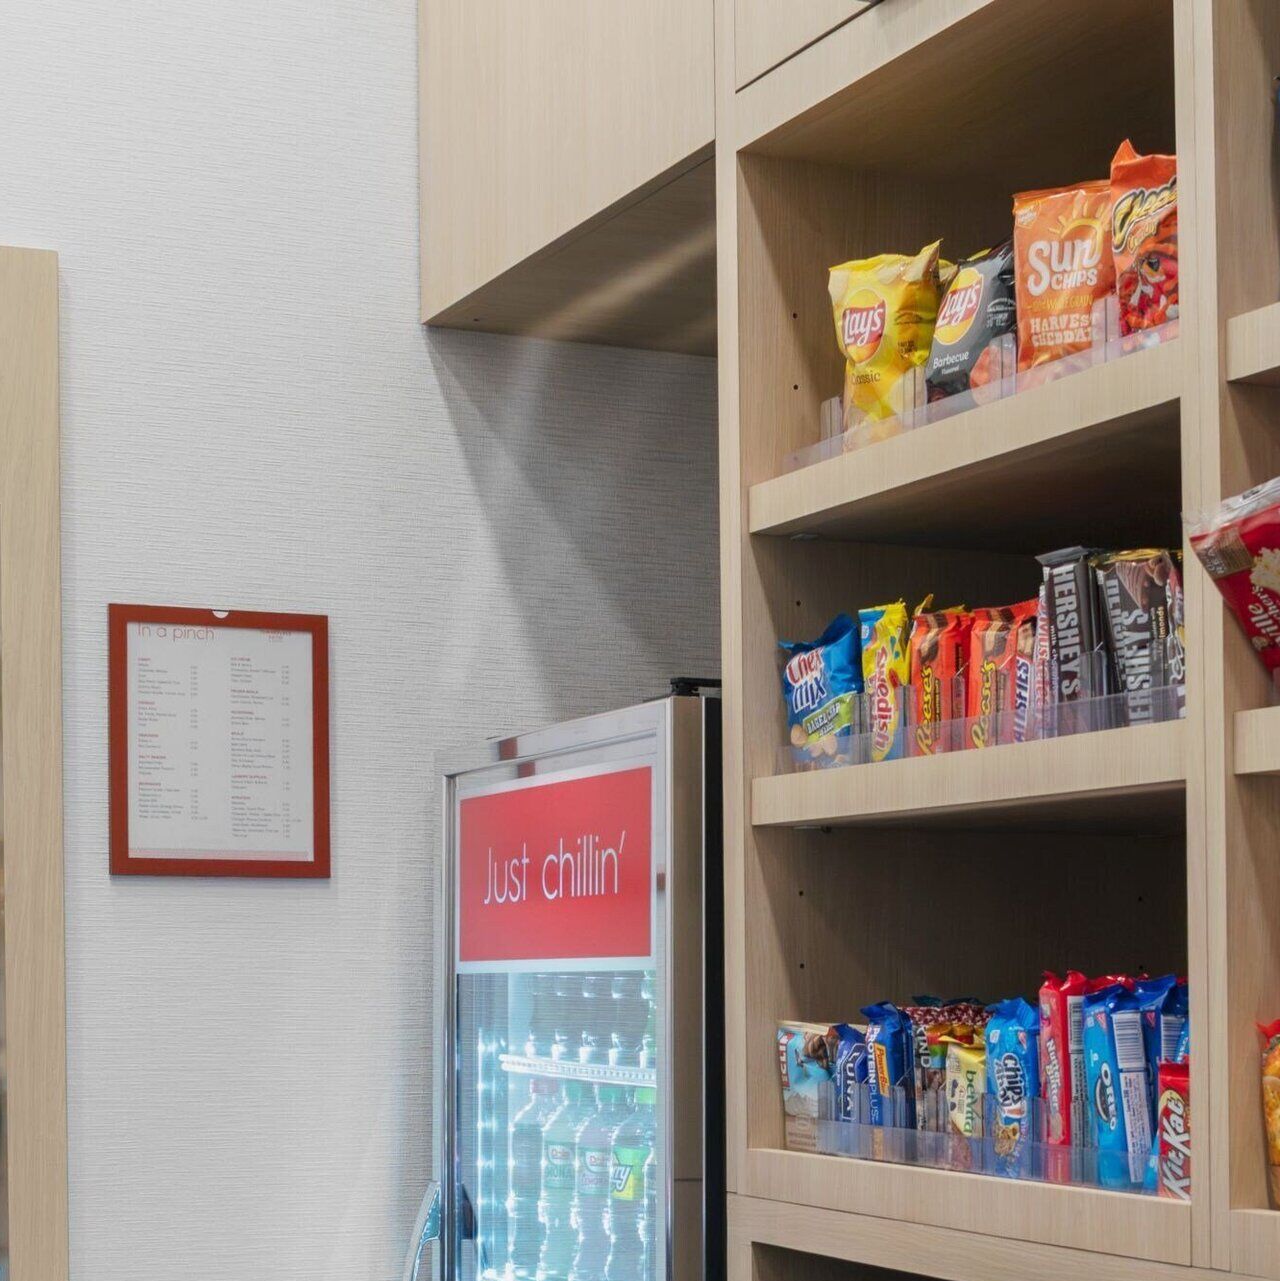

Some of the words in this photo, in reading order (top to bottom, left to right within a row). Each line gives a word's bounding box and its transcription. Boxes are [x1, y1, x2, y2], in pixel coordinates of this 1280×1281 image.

[1027, 238, 1102, 297] Sun
[1050, 268, 1098, 291] CHIPS
[843, 304, 885, 347] Lay's
[936, 283, 981, 328] Lay's
[932, 350, 970, 369] Barbecue
[137, 624, 151, 639] In
[157, 629, 168, 639] a
[173, 625, 215, 643] pinch
[1051, 564, 1081, 697] HERSHEY'S
[874, 645, 893, 751] Swedish
[483, 842, 530, 904] Just
[542, 829, 626, 900] chillin'
[845, 1051, 857, 1112] LUNA
[1001, 1052, 1025, 1108] Chips
[1046, 1037, 1062, 1088] Nutter
[1100, 1062, 1118, 1131] OREO
